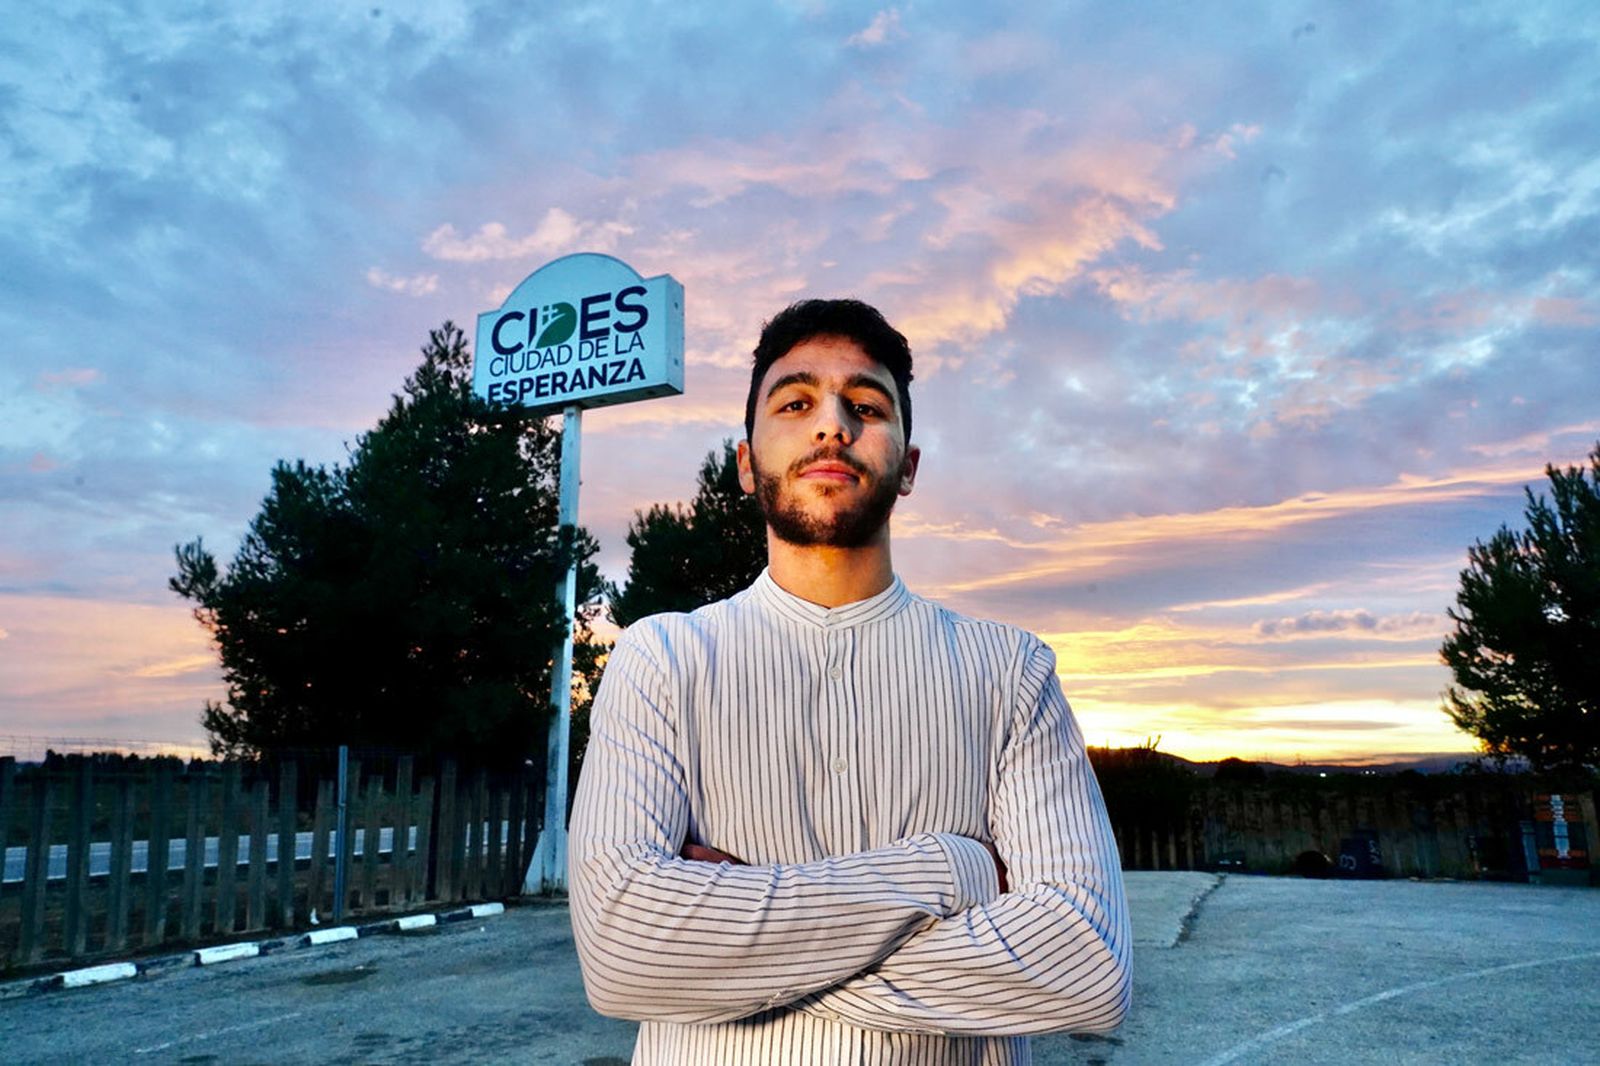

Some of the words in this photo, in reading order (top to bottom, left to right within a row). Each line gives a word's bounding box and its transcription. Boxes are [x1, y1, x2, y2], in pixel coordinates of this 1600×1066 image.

[491, 285, 649, 355] CIDES
[490, 344, 573, 377] CIUDAD
[578, 336, 608, 361] DE
[614, 331, 645, 355] LA
[487, 358, 646, 405] ESPERANZA
